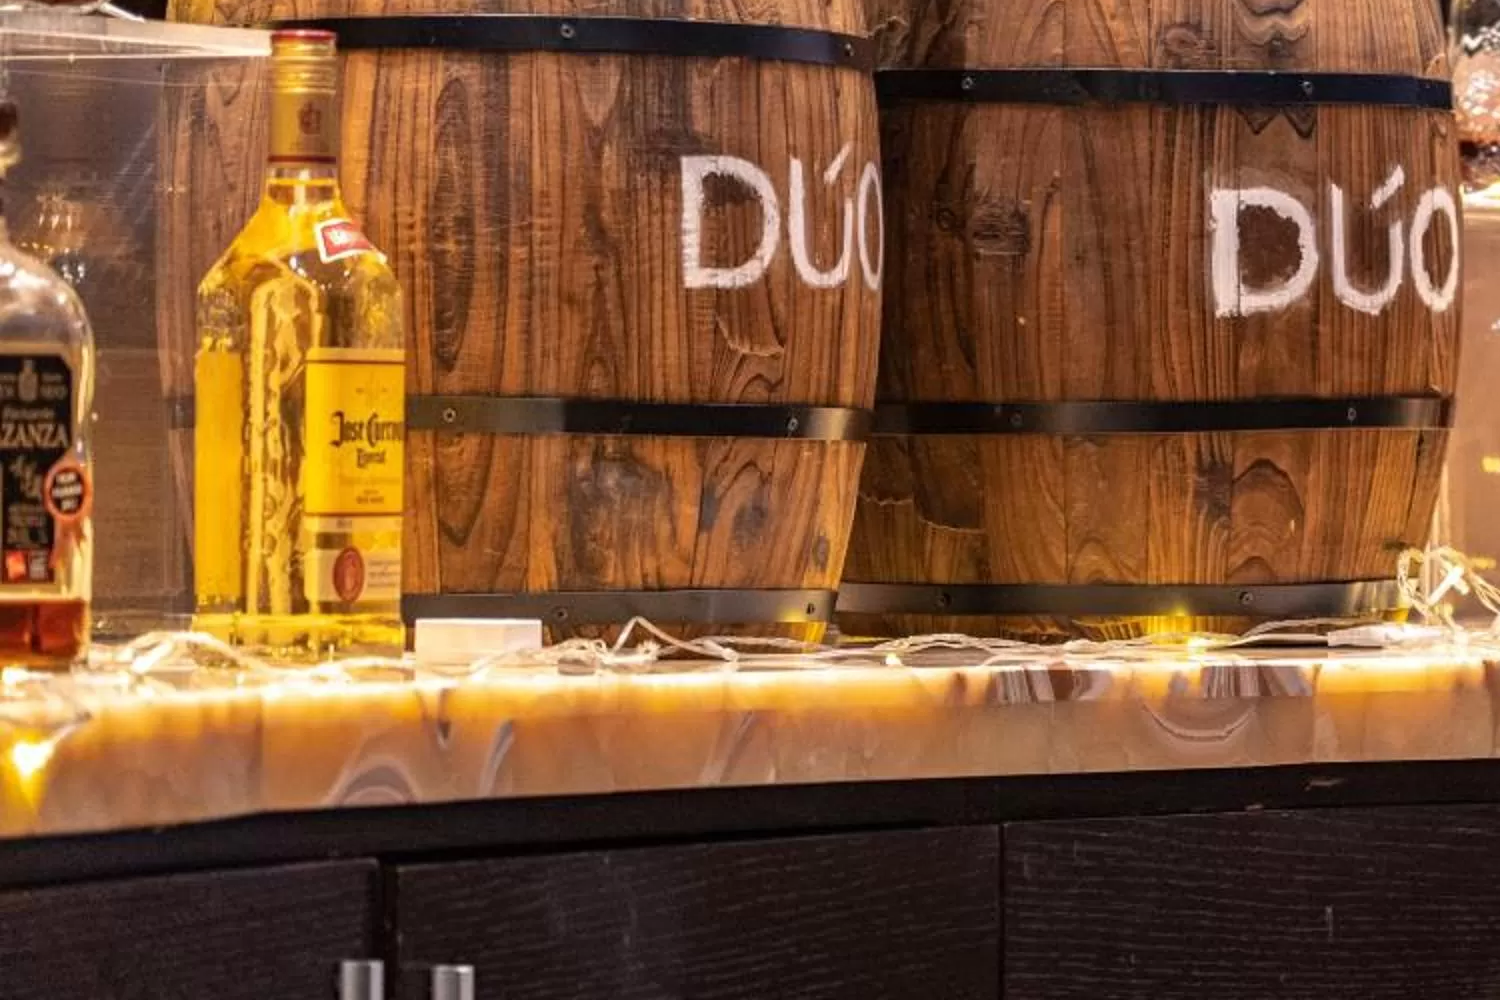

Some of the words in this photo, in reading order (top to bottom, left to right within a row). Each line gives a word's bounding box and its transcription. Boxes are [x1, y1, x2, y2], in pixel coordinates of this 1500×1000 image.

[679, 144, 883, 291] DÚO
[1208, 163, 1461, 317] DÚO
[0, 422, 68, 449] ZANZA
